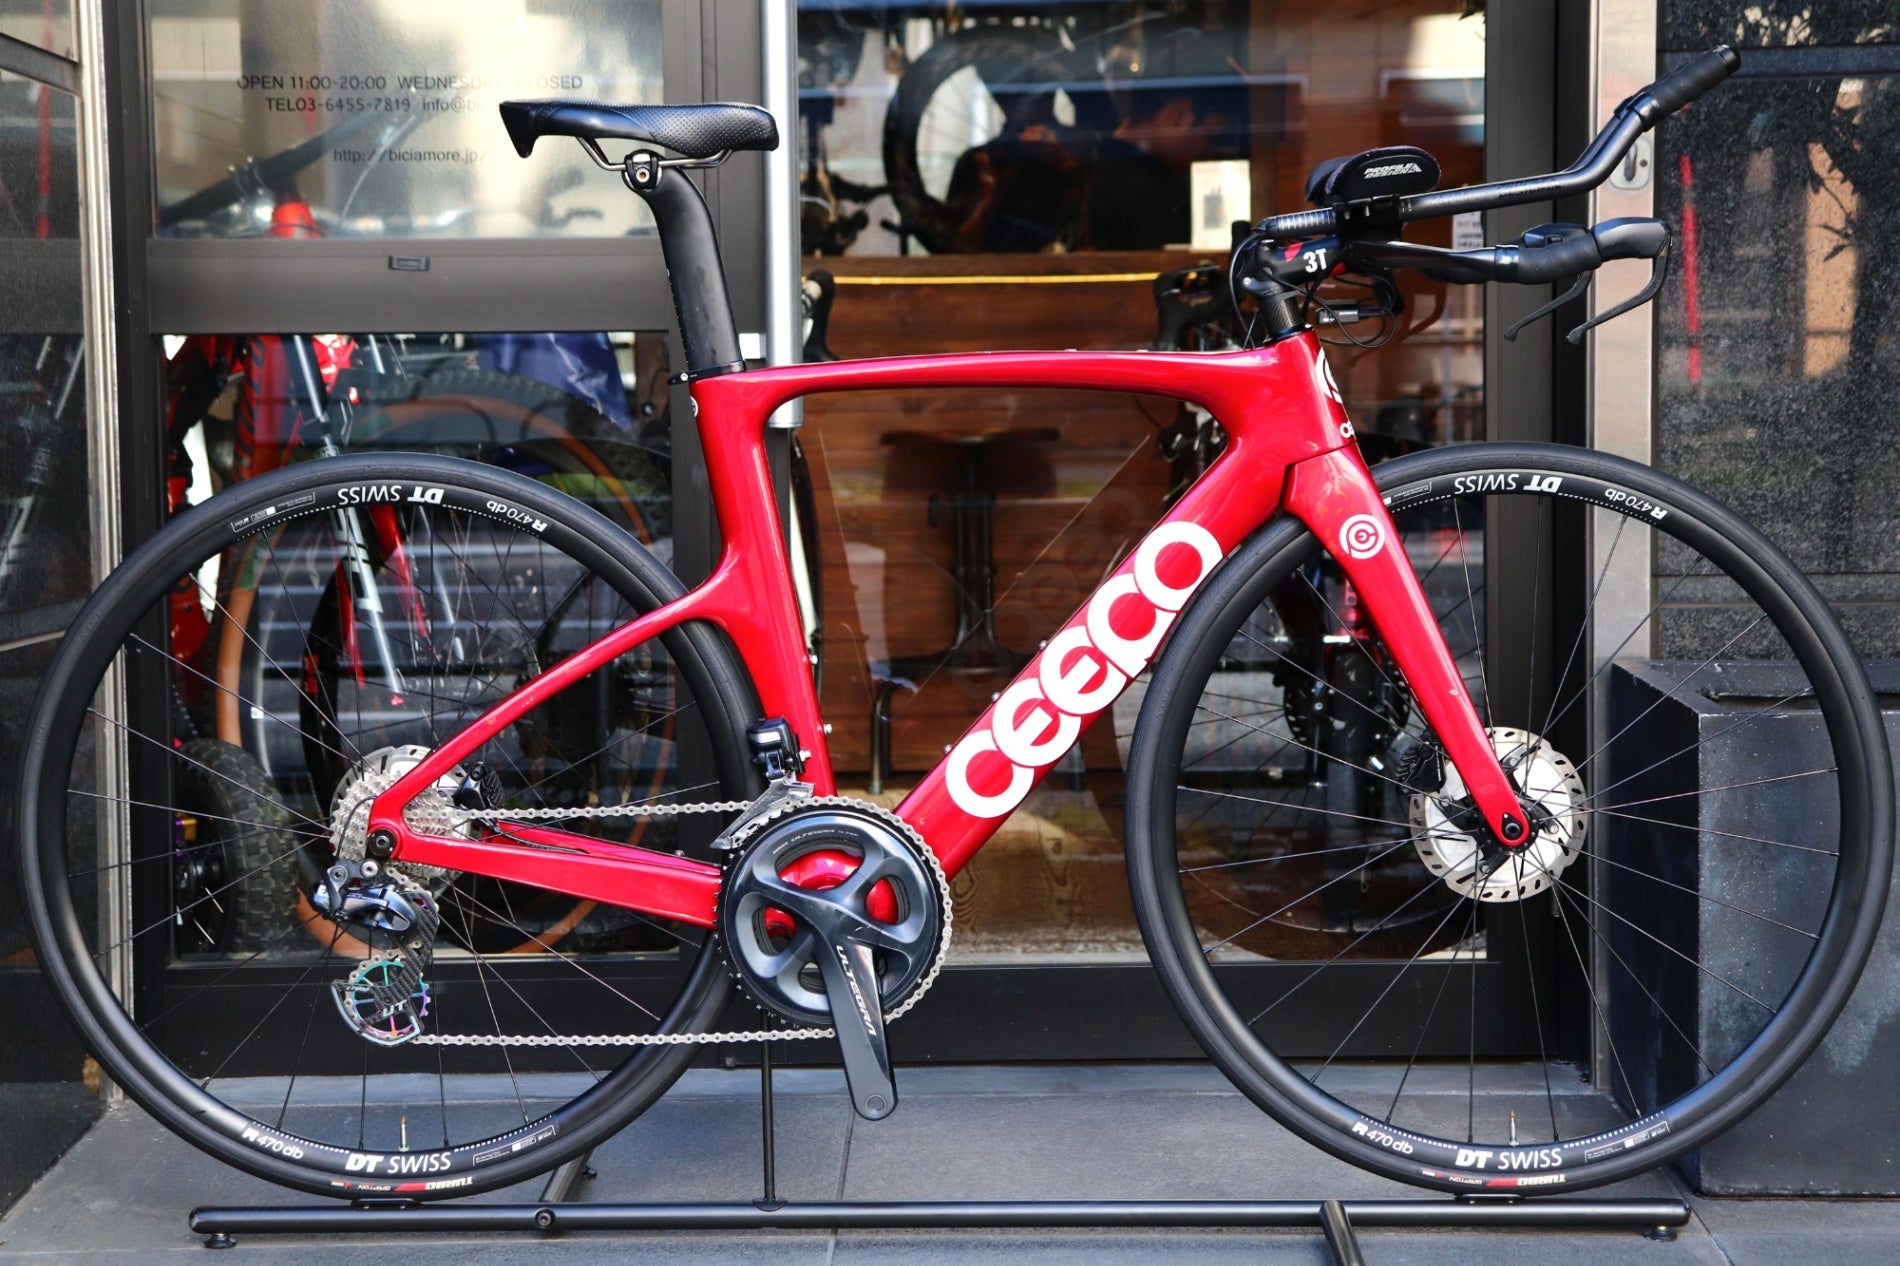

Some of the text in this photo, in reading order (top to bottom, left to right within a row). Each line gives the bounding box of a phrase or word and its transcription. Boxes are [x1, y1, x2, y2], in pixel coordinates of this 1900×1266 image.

[237, 75, 582, 90] OPEN 11:00-20:00 WEDNESDA OSED
[1304, 249, 1326, 273] 3T
[337, 485, 445, 505] DT SWISS
[1454, 473, 1563, 495] DT SWISS
[836, 944, 876, 1036] ULTEGRA
[345, 1152, 451, 1174] DT SWISS
[1455, 1148, 1562, 1170] DT SWISS
